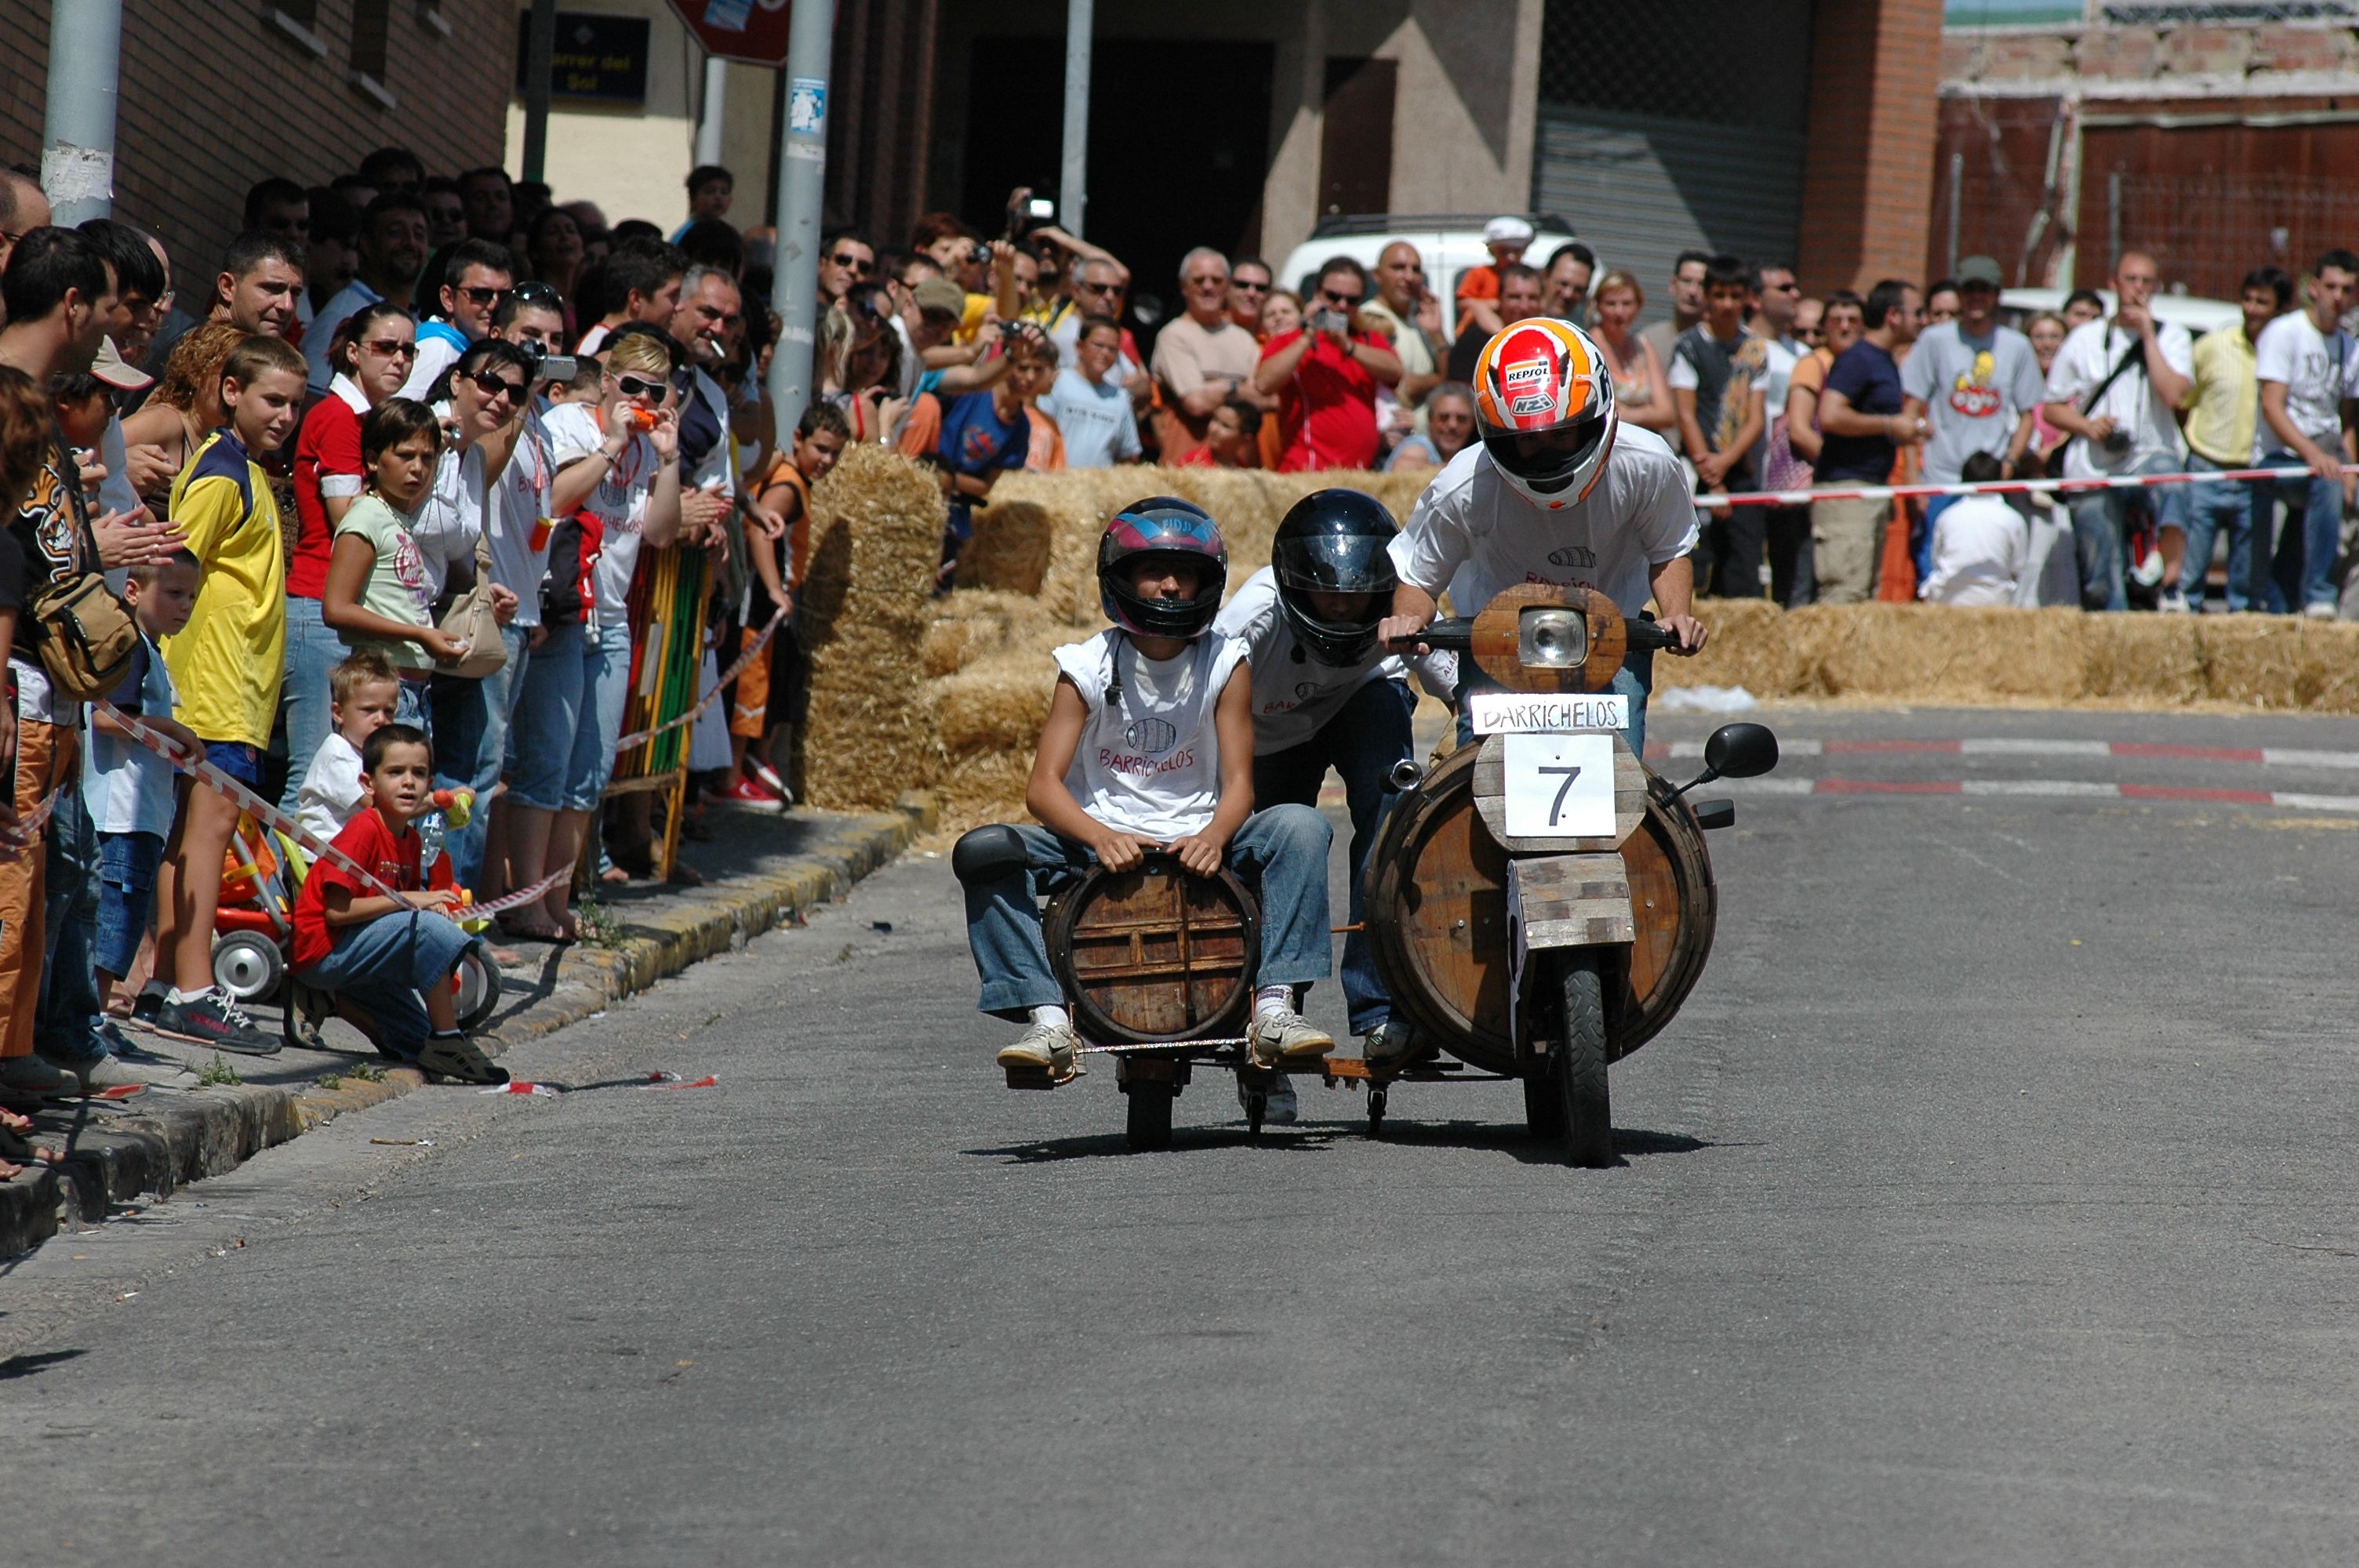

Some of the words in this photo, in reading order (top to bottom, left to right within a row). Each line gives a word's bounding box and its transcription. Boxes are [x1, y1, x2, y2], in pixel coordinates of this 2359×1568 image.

[552, 53, 597, 69] arrer
[1508, 368, 1549, 382] REPSOL
[1162, 518, 1192, 532] FIDJI
[1538, 766, 1581, 826] 7
